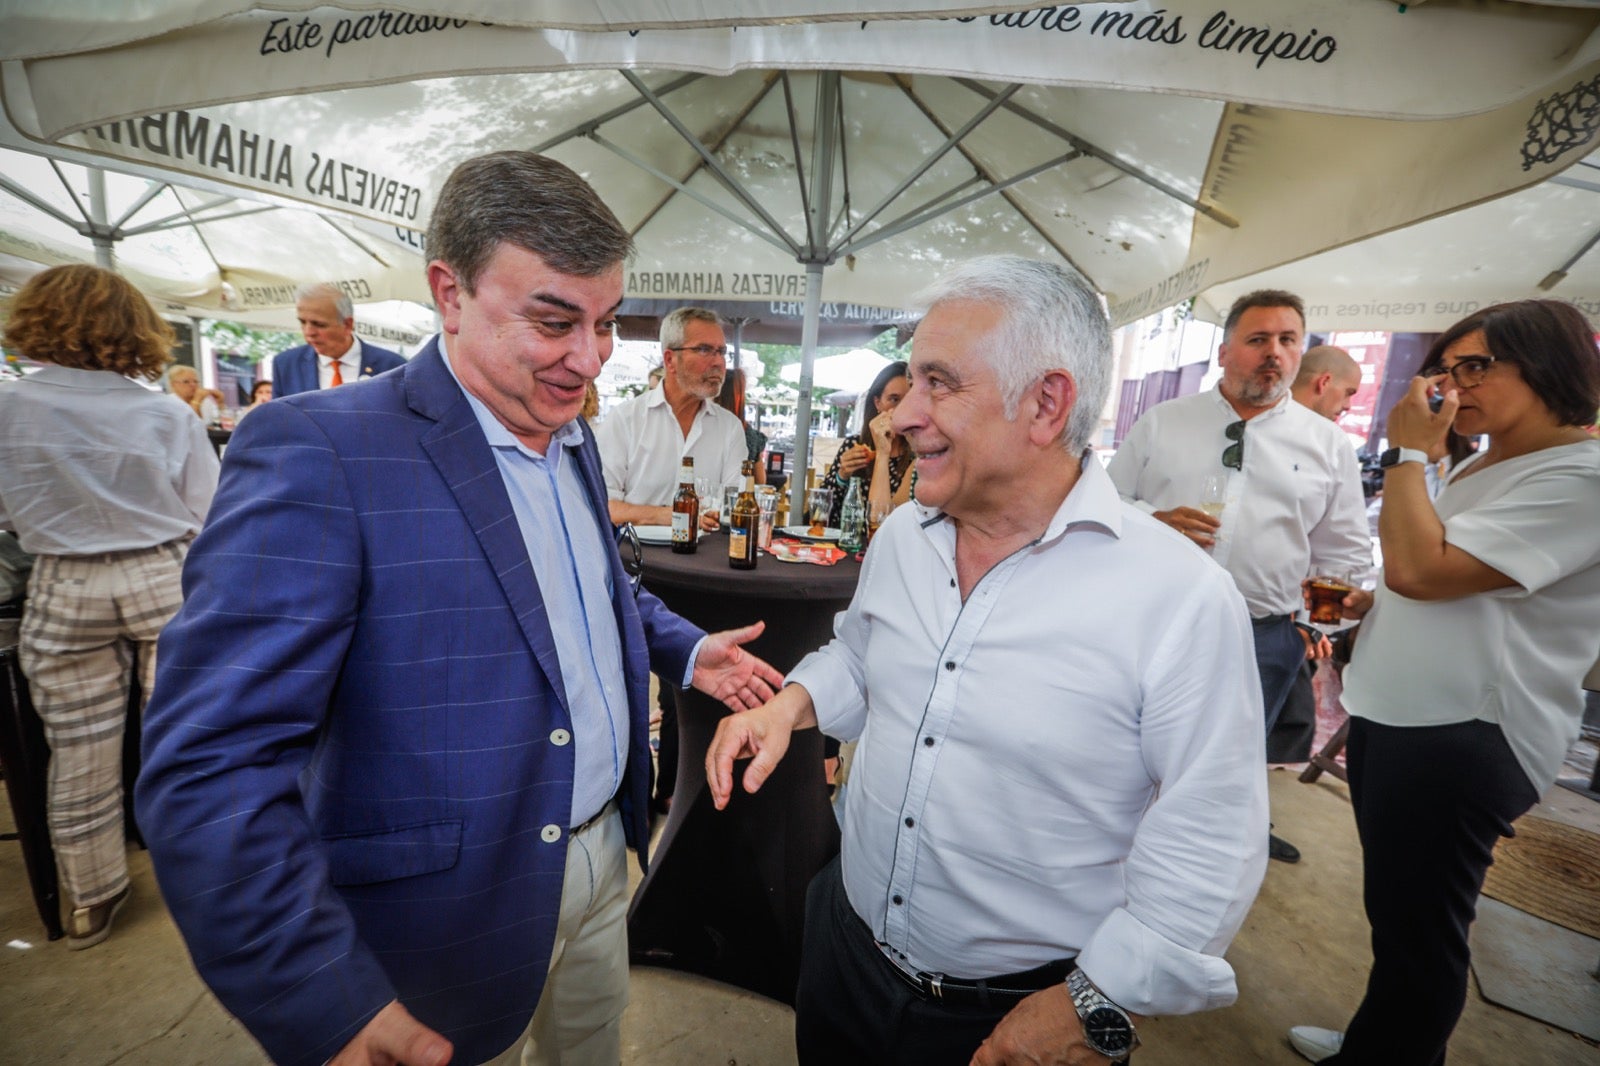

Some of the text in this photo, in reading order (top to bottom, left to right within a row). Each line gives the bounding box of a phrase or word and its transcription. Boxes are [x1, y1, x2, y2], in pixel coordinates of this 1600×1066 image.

[260, 17, 323, 56] Este
[1090, 8, 1187, 45] más
[1198, 10, 1338, 69] limpio
